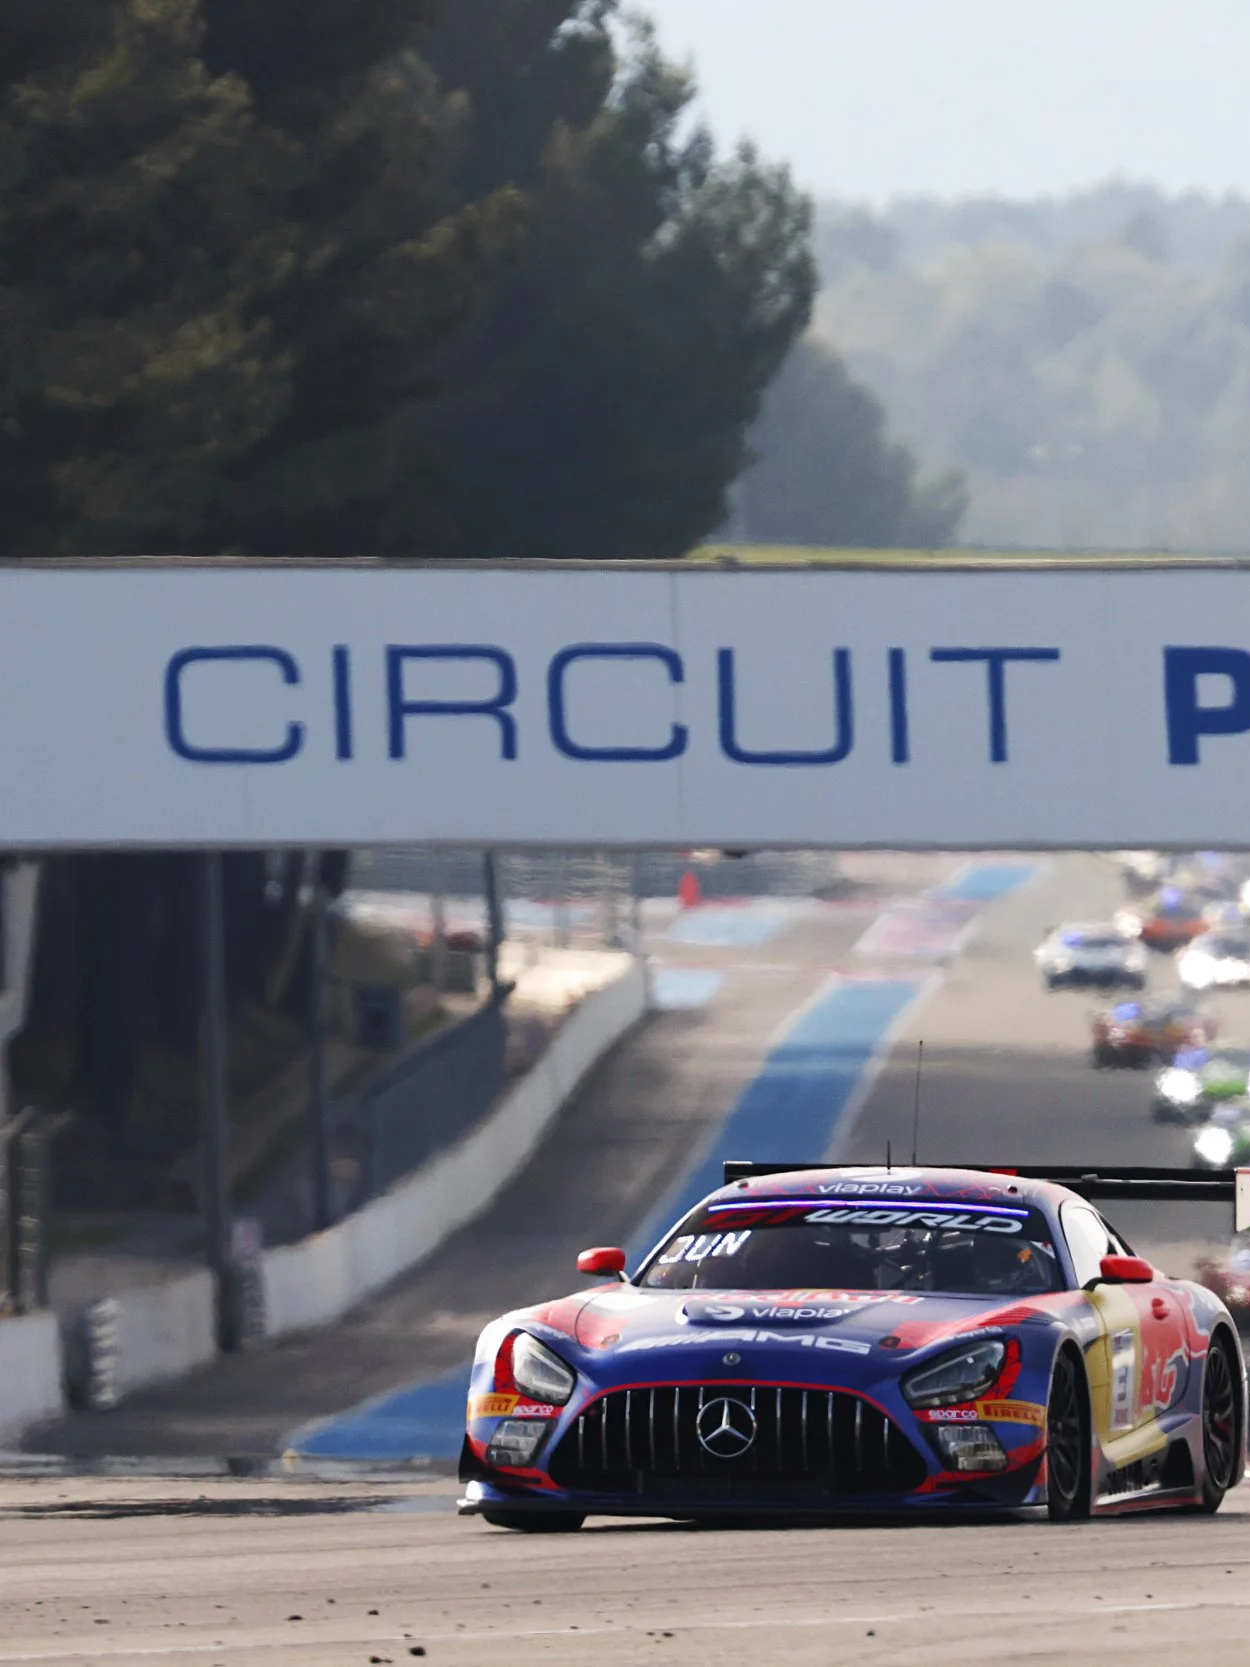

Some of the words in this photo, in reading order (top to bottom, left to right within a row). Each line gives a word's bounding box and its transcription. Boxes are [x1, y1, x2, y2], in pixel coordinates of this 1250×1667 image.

[161, 642, 1063, 768] CIRCUIT
[816, 1182, 923, 1197] viaplay
[804, 1208, 1023, 1234] WORLD
[658, 1229, 753, 1265] JUN
[928, 1409, 978, 1420] sparco
